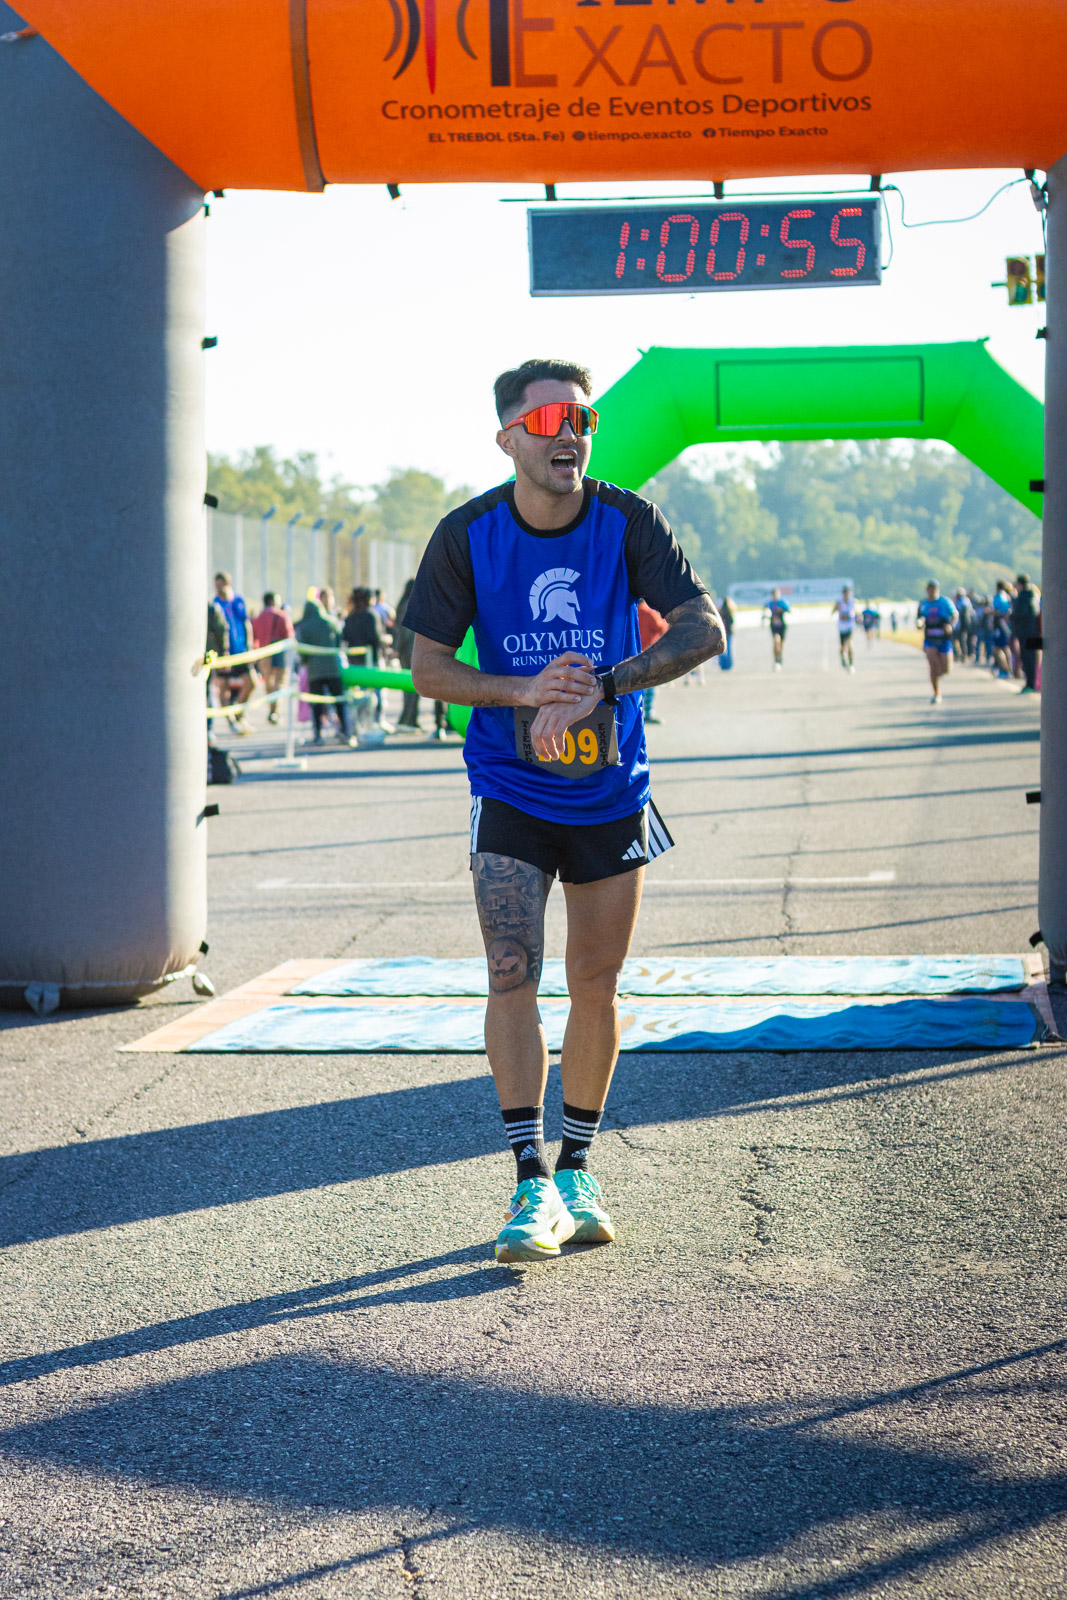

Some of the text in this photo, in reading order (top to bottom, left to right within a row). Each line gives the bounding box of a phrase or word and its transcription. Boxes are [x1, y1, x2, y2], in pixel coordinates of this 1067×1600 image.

[513, 0, 873, 88] EXACTO
[381, 93, 872, 122] Cronometraje de Eventos Deportivos
[428, 132, 446, 143] EL
[448, 131, 504, 142] TREBOL
[508, 130, 541, 143] (Sta.
[543, 130, 565, 142] Fe)
[718, 127, 775, 139] Tiempo
[779, 126, 828, 137] Exacto
[615, 207, 866, 283] 1:00:55
[503, 629, 605, 654] OLYMPUS
[512, 653, 561, 667] RUNNI
[521, 720, 533, 763] TIEMPO
[538, 728, 599, 765] 09
[598, 723, 609, 767] EXACTO
